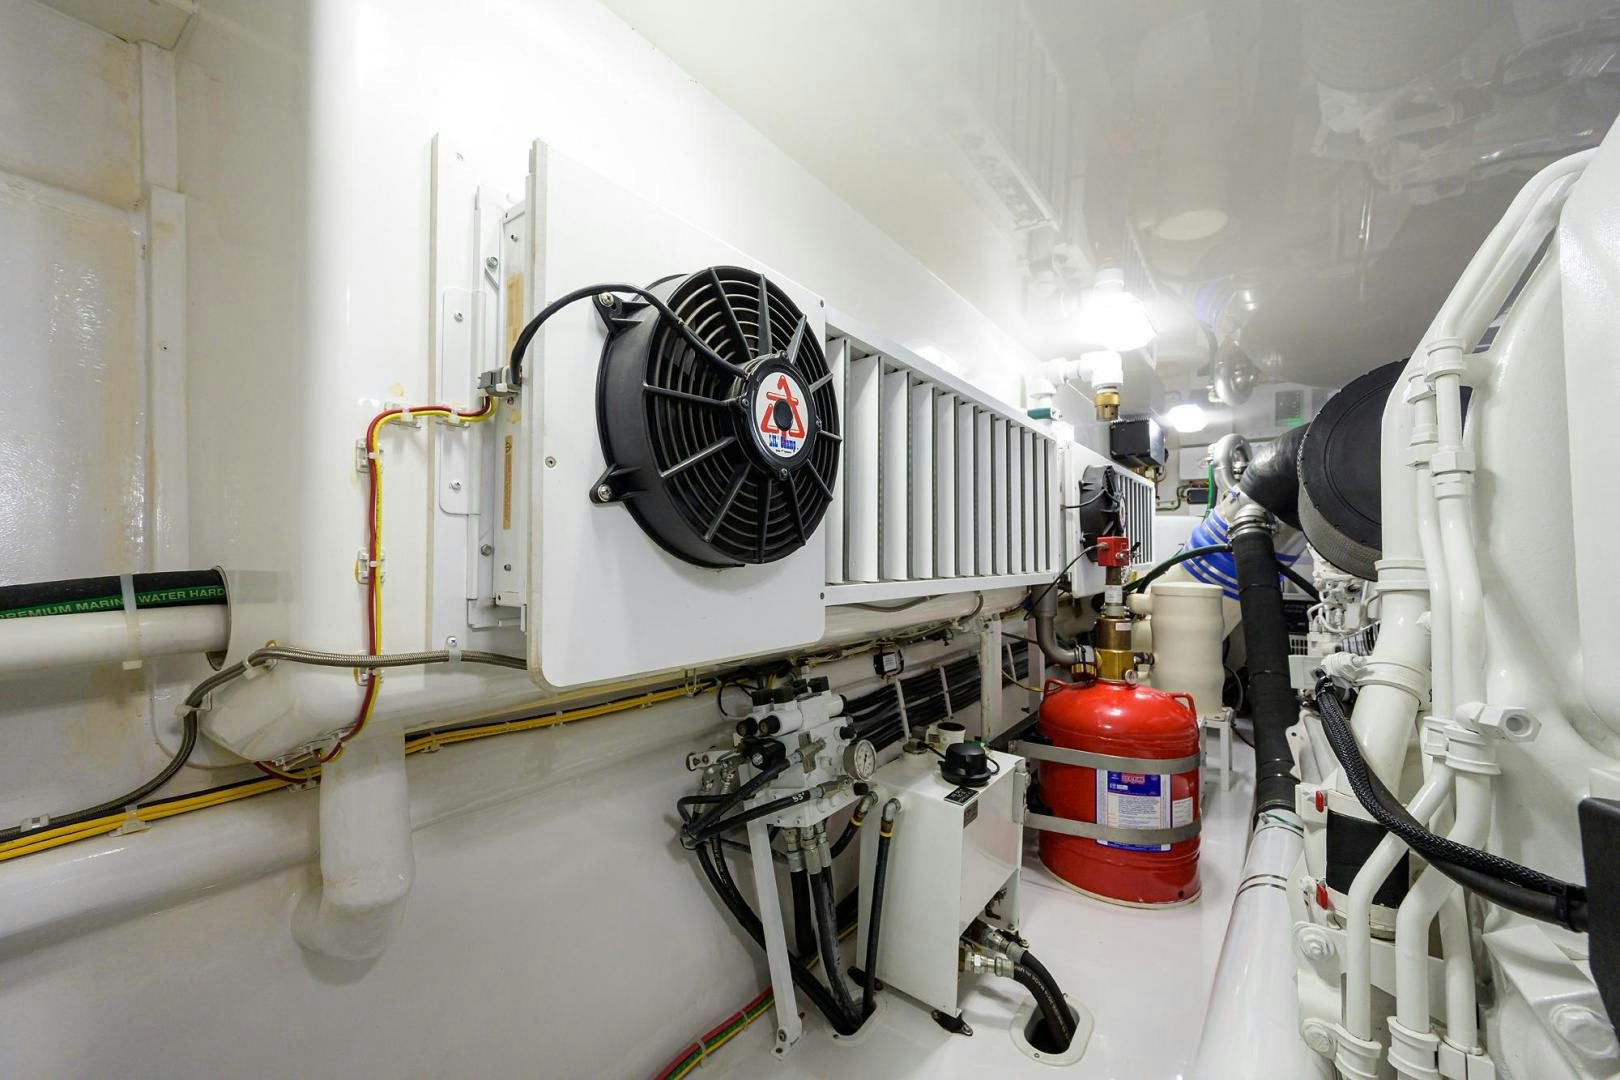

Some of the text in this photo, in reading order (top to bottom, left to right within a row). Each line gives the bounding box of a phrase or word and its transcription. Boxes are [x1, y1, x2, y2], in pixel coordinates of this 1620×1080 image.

[76, 598, 124, 611] MARIN
[138, 591, 186, 603] WATER
[190, 588, 225, 598] HARD
